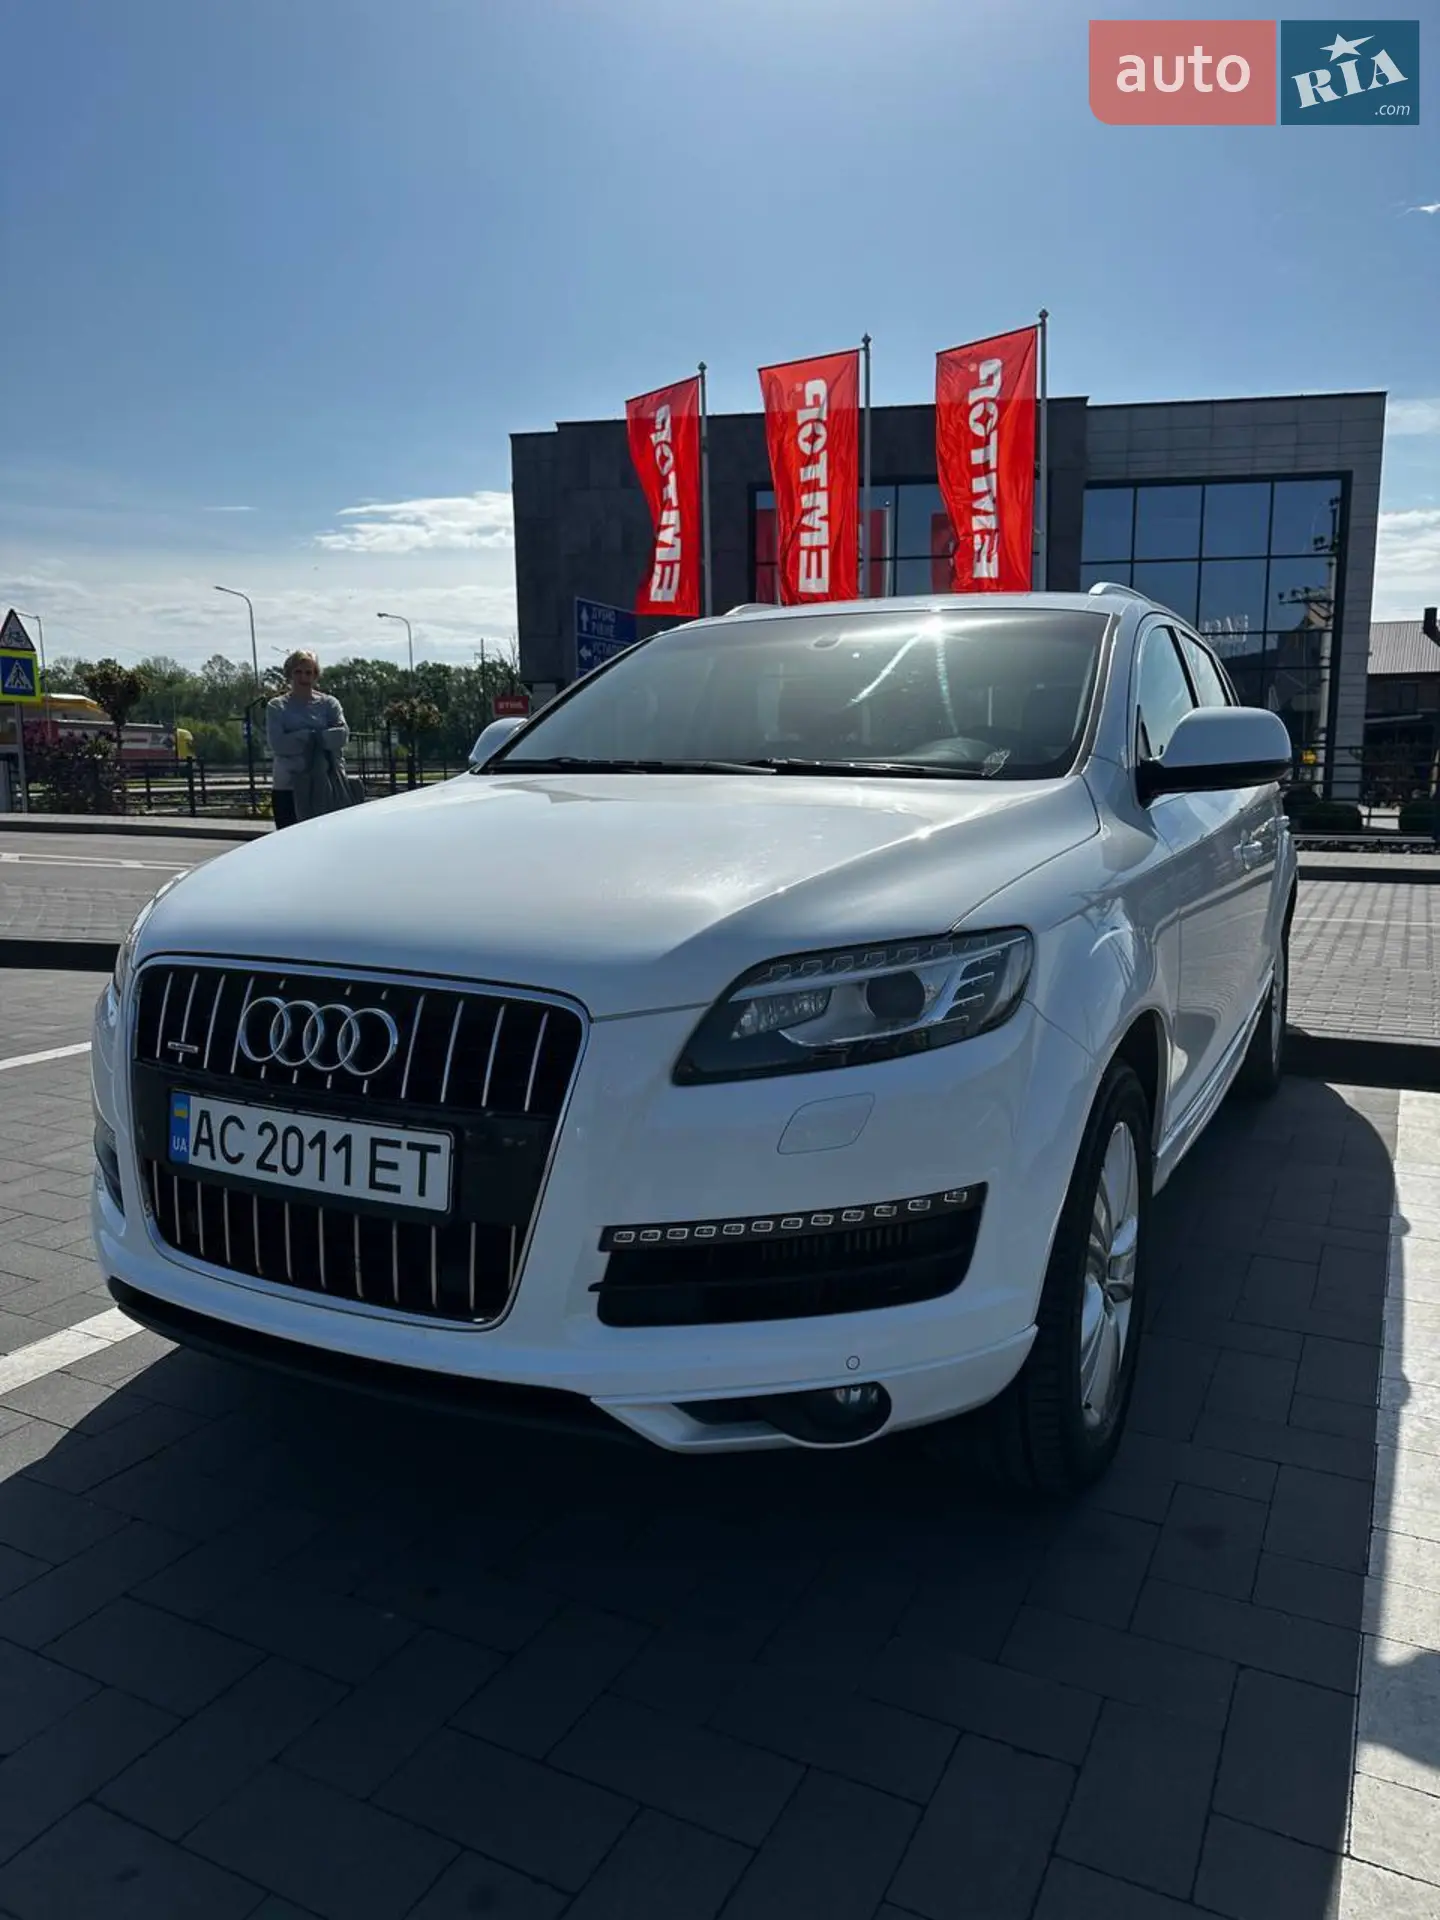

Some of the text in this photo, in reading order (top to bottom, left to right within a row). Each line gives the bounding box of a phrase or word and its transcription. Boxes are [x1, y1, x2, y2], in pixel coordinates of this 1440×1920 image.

[172, 1135, 188, 1153] UA
[192, 1109, 442, 1197] AC 2011 ET
